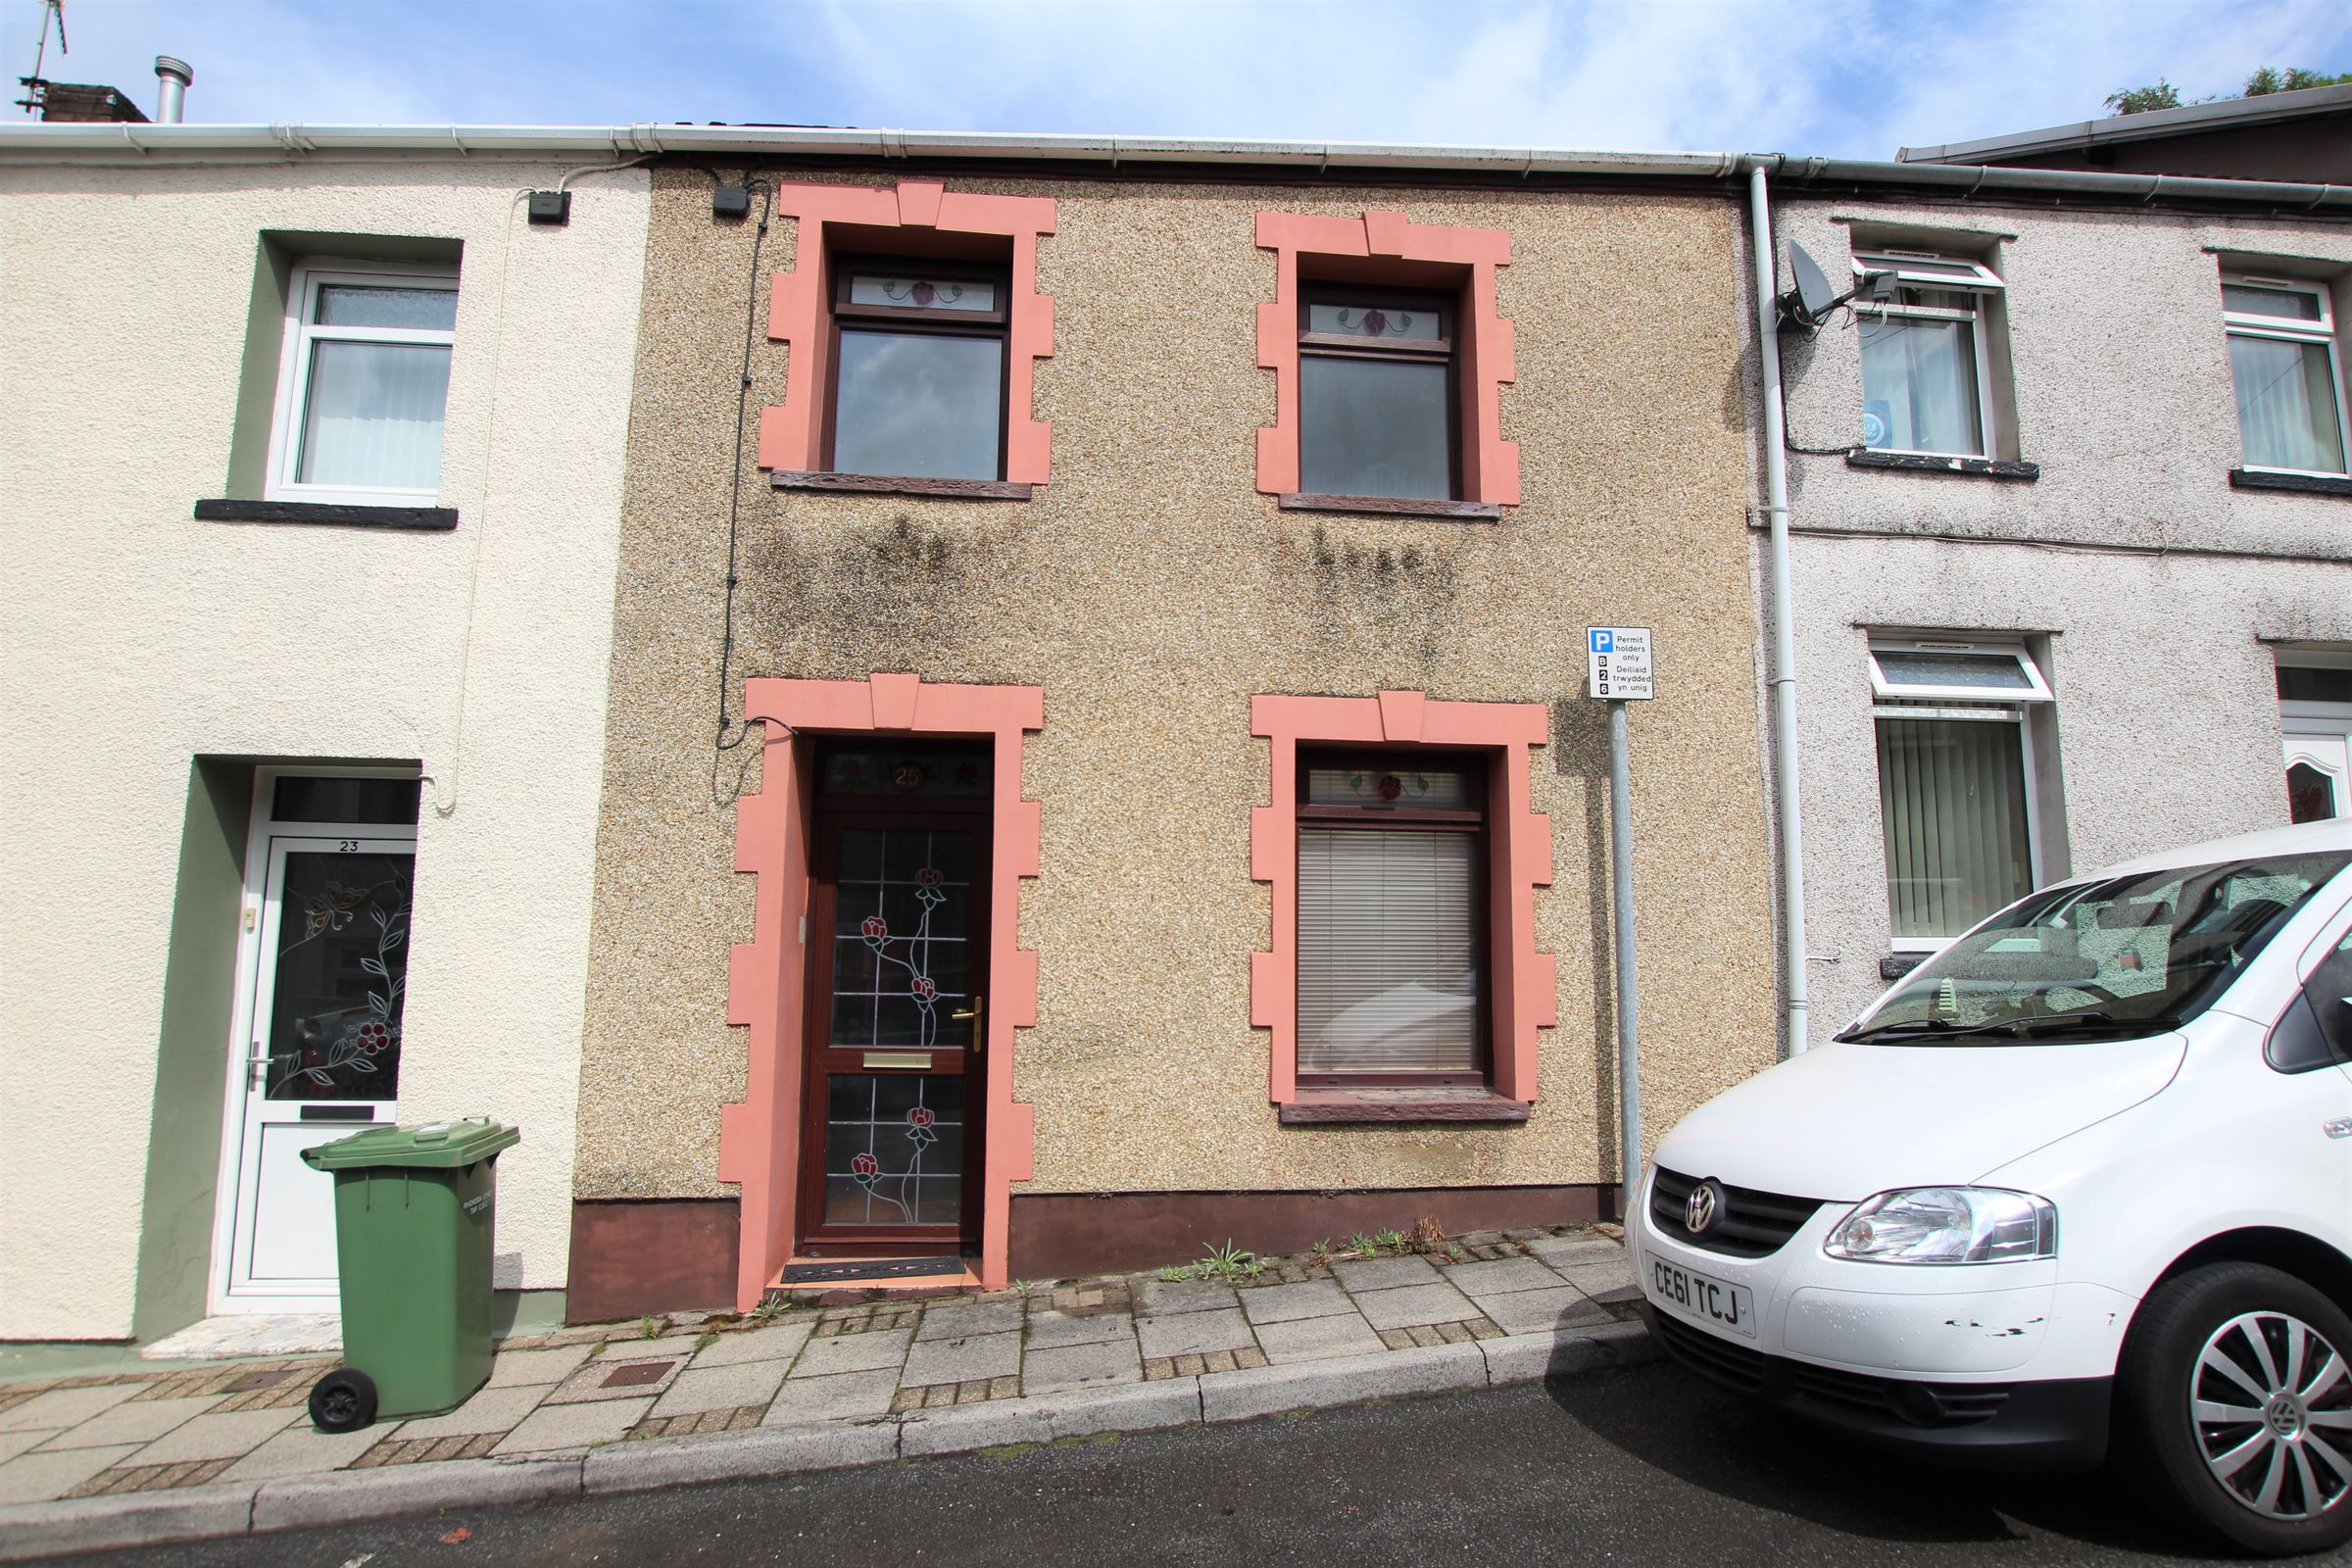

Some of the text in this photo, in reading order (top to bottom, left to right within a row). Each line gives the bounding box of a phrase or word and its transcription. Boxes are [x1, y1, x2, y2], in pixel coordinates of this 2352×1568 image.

[1595, 632, 1610, 651] P
[1599, 657, 1606, 665] B
[1622, 654, 1640, 662] only
[1631, 684, 1647, 693] unig
[895, 767, 918, 785] 25
[339, 841, 359, 852] 23
[1654, 1260, 1739, 1325] CE61 TCJ
